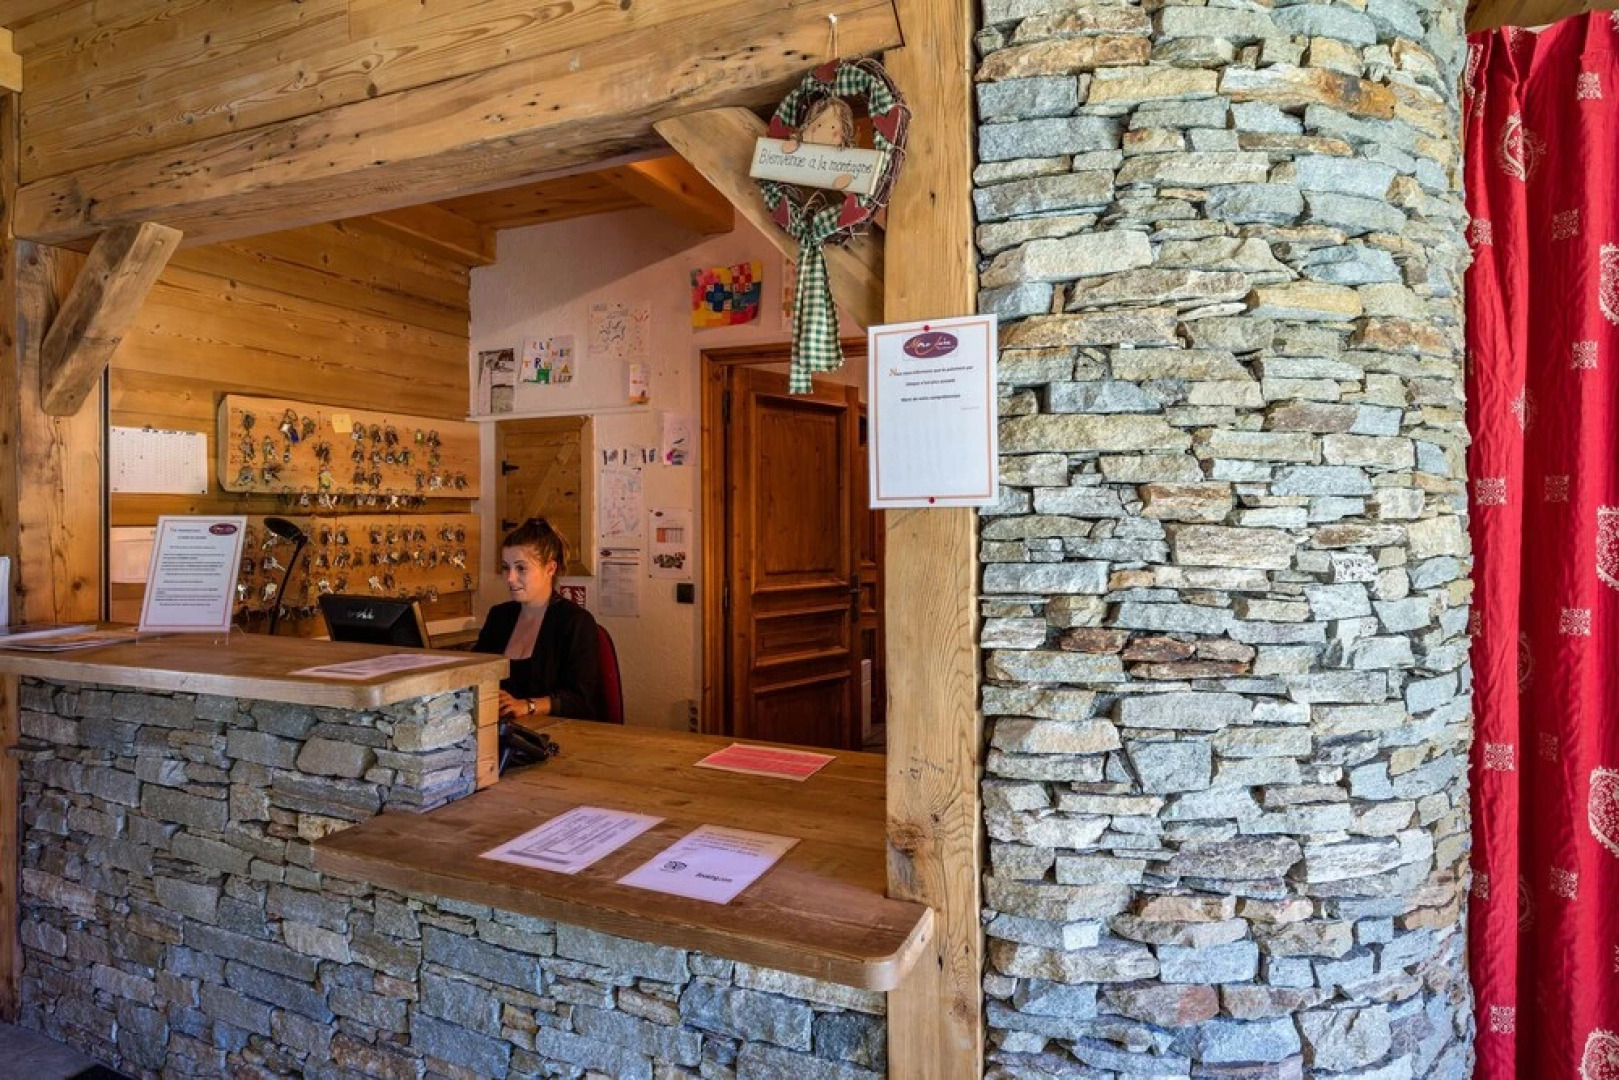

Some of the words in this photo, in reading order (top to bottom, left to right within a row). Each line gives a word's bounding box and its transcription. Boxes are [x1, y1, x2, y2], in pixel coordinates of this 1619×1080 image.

[759, 148, 807, 168] Bienvenue
[817, 154, 827, 171] la
[829, 159, 873, 180] montagne
